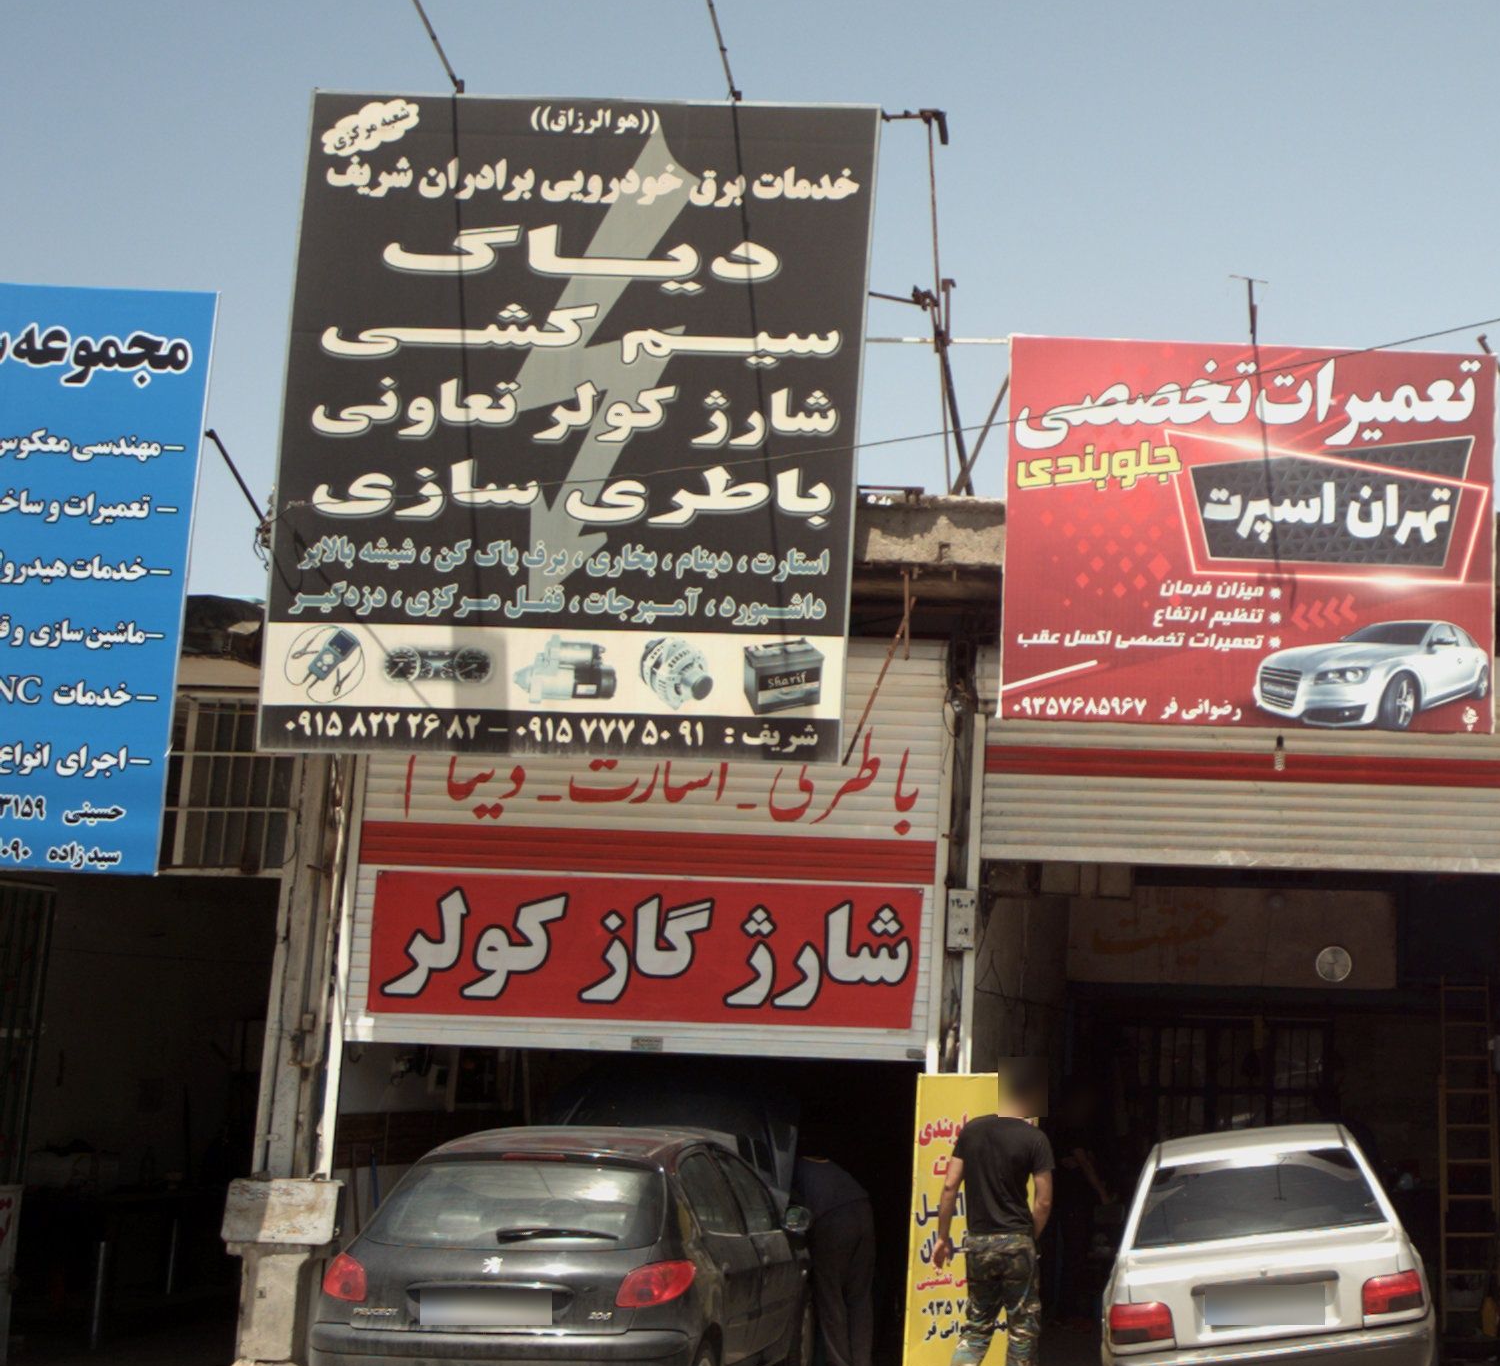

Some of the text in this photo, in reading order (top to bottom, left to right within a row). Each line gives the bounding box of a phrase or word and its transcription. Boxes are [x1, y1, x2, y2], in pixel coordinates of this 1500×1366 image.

[326, 154, 860, 208] خدمات برق خودرویی برادران شریف
[321, 302, 843, 367] سیم کشی
[11, 322, 193, 387] مجموعه
[311, 375, 839, 449] شارژ کولر تعاونی
[1013, 357, 1483, 451] تعمیرات تخصصی
[72, 435, 163, 463] مهندسی
[1016, 439, 1183, 492] جلوبندی
[0, 488, 152, 525] تعمیرات و ساخ
[311, 457, 836, 528] باطری سازی
[1202, 480, 1452, 546] تهران اسپرت
[0, 549, 149, 584] خدمات هیدرو
[297, 534, 356, 570] بالابر
[358, 536, 417, 570] شیشه
[434, 538, 472, 572] کن
[474, 539, 520, 576] پاک
[522, 539, 569, 576] برف
[586, 543, 658, 577] بخاری
[675, 545, 733, 579] دینام
[751, 548, 830, 583] استارت
[288, 580, 388, 616] دزدگیر
[404, 583, 502, 618] مرکزی
[504, 583, 566, 619] قفل
[1160, 578, 1266, 600] میزان فرمان
[718, 592, 828, 626] داشبورد
[1152, 605, 1265, 630] تنظیم ارتفاع
[11, 624, 25, 647] و
[29, 618, 84, 648] سازی
[84, 620, 146, 650] ماشین
[1016, 628, 1264, 653] تعمیرات تخصصی اکسل عقب
[53, 679, 133, 707] خدمات
[1160, 695, 1178, 720] فر
[1181, 697, 1243, 722] رضوانی
[55, 742, 129, 778] اجرای
[768, 725, 919, 835] باطری
[62, 800, 127, 825] حسینی
[380, 885, 910, 1011] شارژ گاز کولر
[918, 1113, 969, 1148] لوبندی
